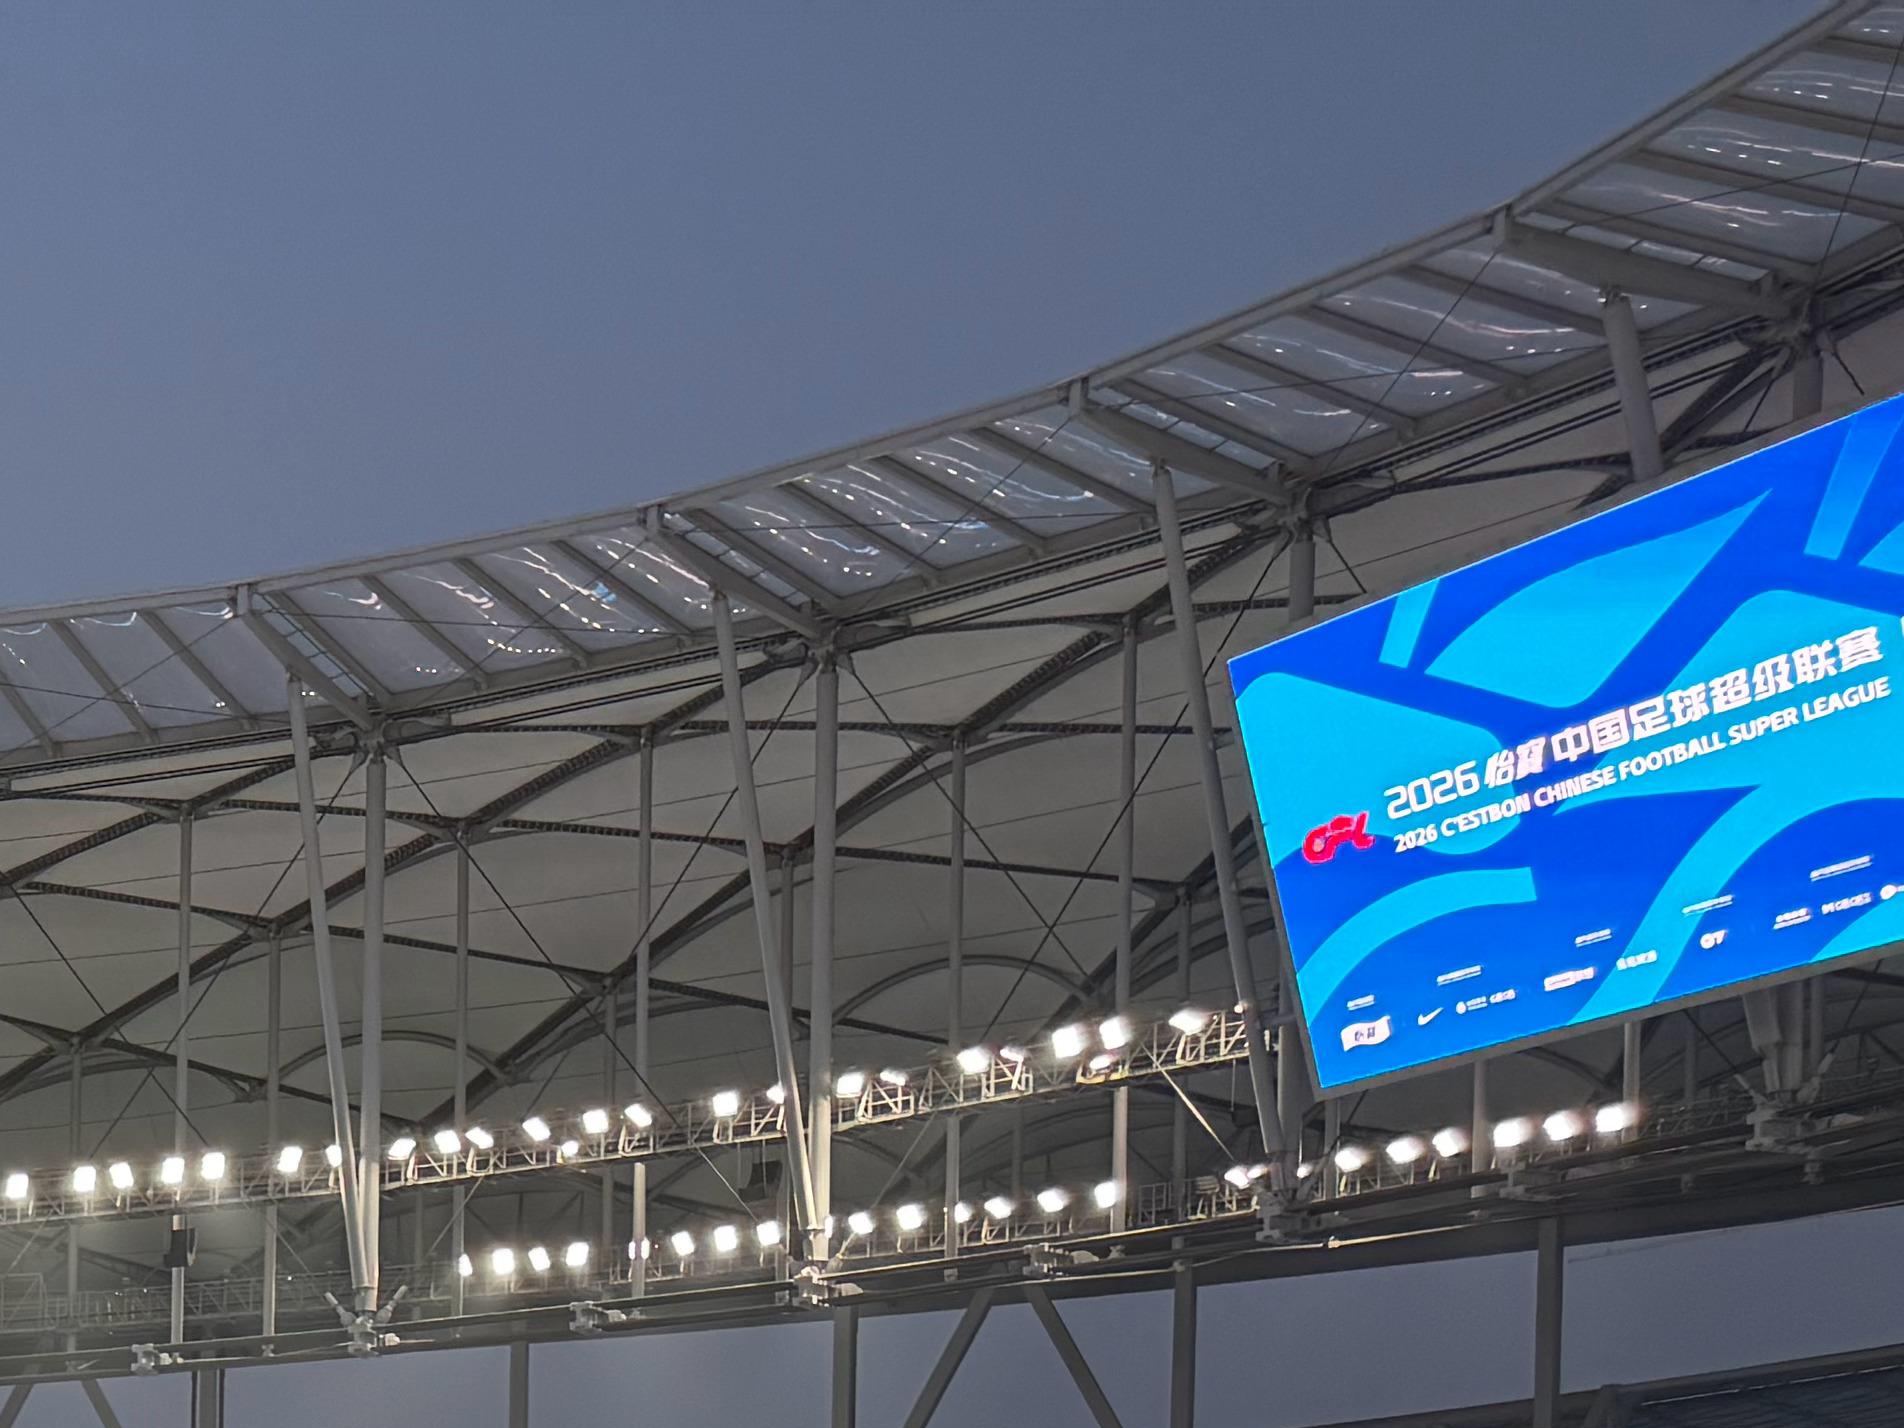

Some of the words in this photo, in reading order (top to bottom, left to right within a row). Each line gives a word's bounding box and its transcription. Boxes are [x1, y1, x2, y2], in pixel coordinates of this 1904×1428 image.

[1384, 761, 1479, 820] 2026
[1552, 626, 1884, 765] 中国足球超级联赛
[1393, 825, 1438, 854] 2026
[1441, 792, 1531, 839] C'ESTBON
[1534, 765, 1617, 809] CHINESE
[1619, 731, 1726, 782] FOOTBALL
[1727, 709, 1800, 748] SUPER
[1803, 676, 1892, 722] LEAGUE
